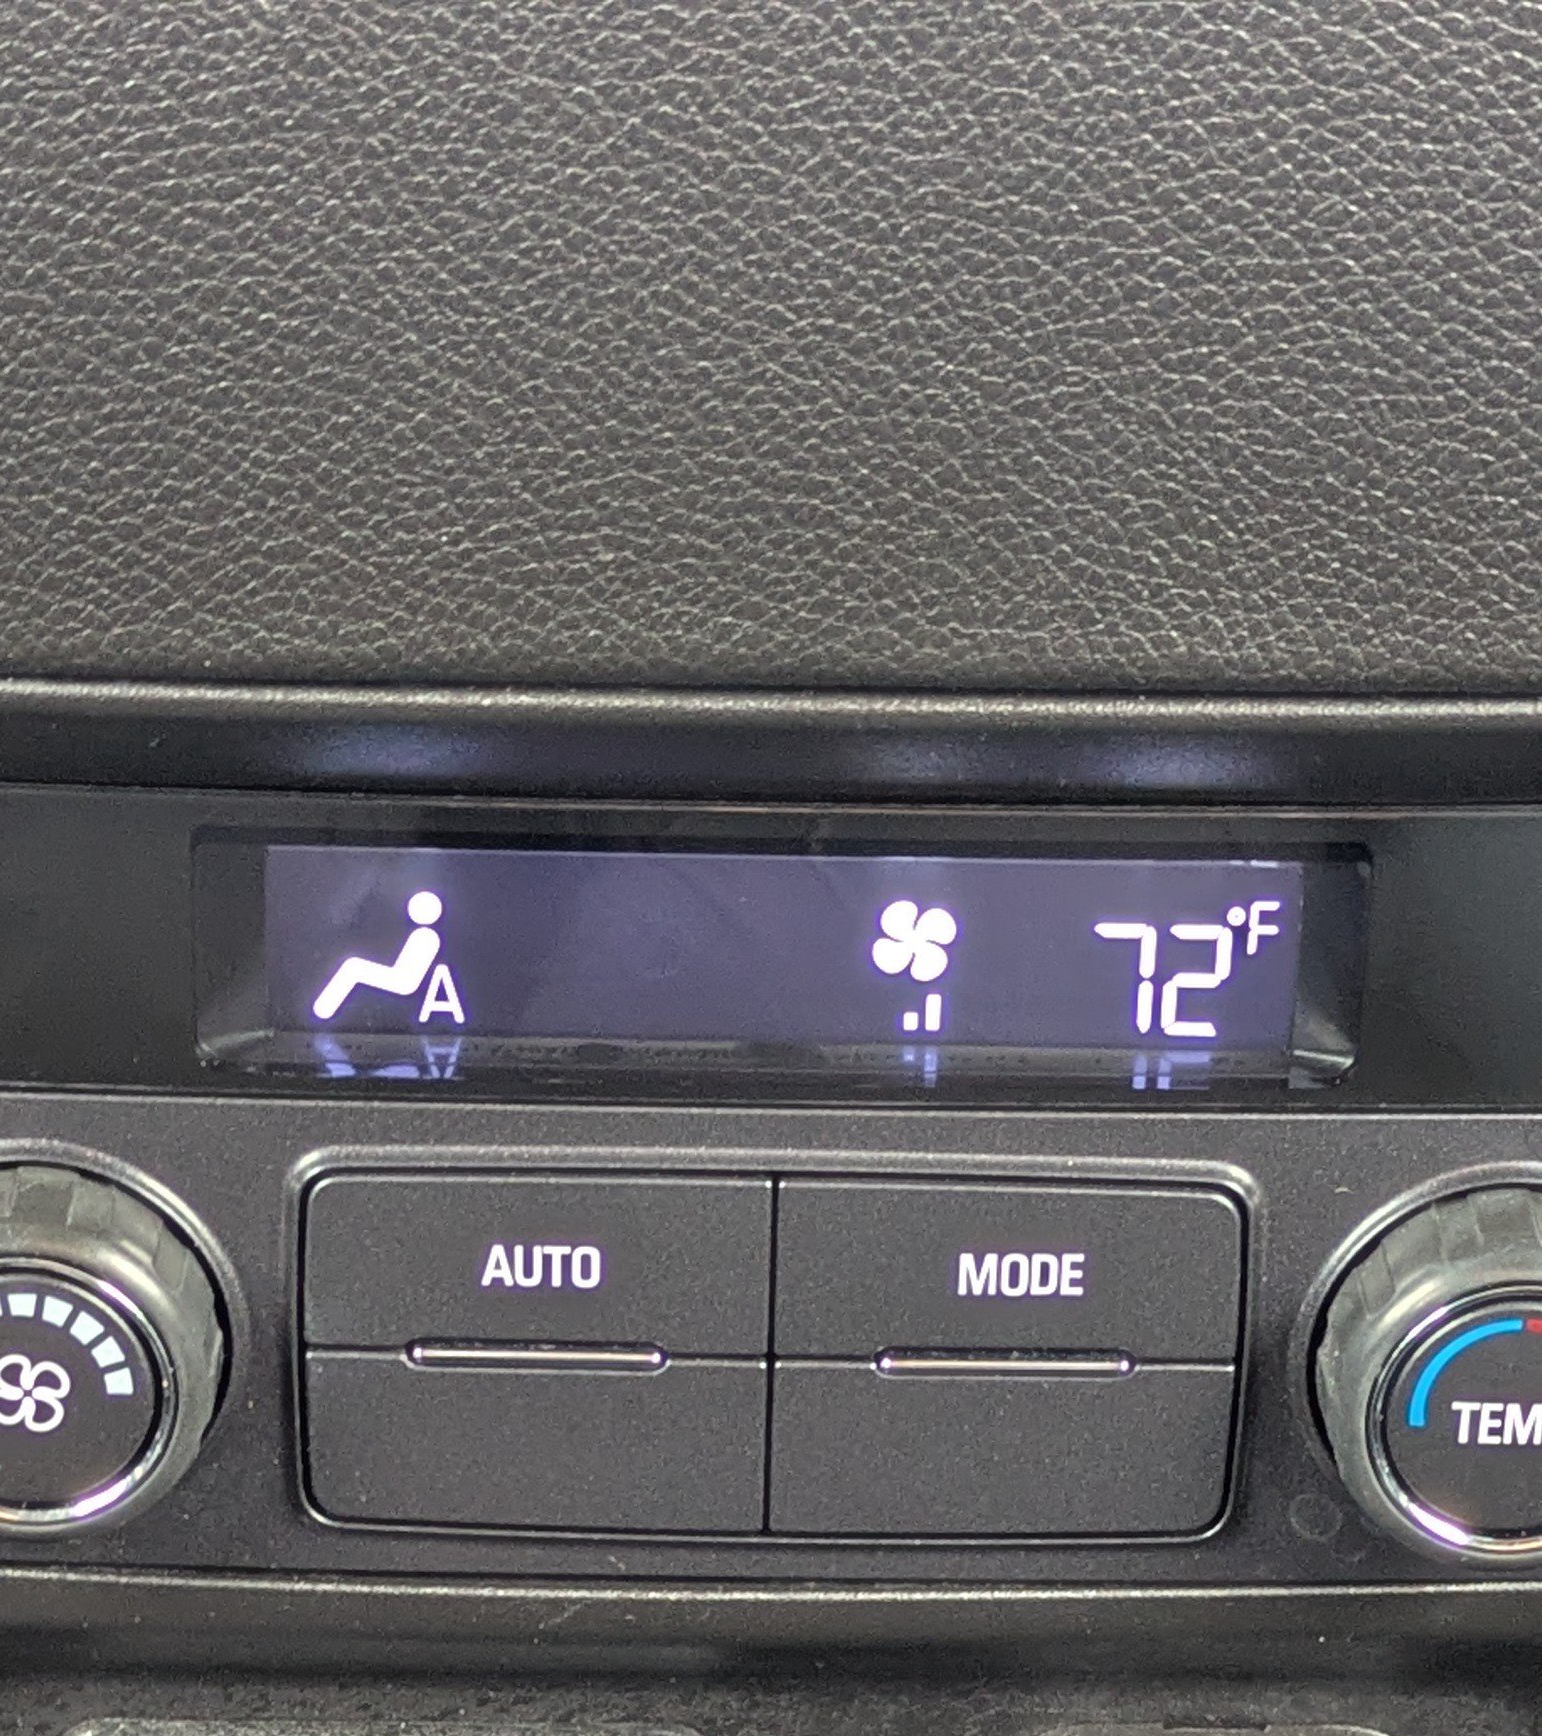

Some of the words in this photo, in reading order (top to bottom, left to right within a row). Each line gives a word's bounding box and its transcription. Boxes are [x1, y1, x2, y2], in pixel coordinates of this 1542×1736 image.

[419, 964, 465, 1023] A
[480, 1243, 602, 1289] AUTO
[957, 1252, 1086, 1297] MODE
